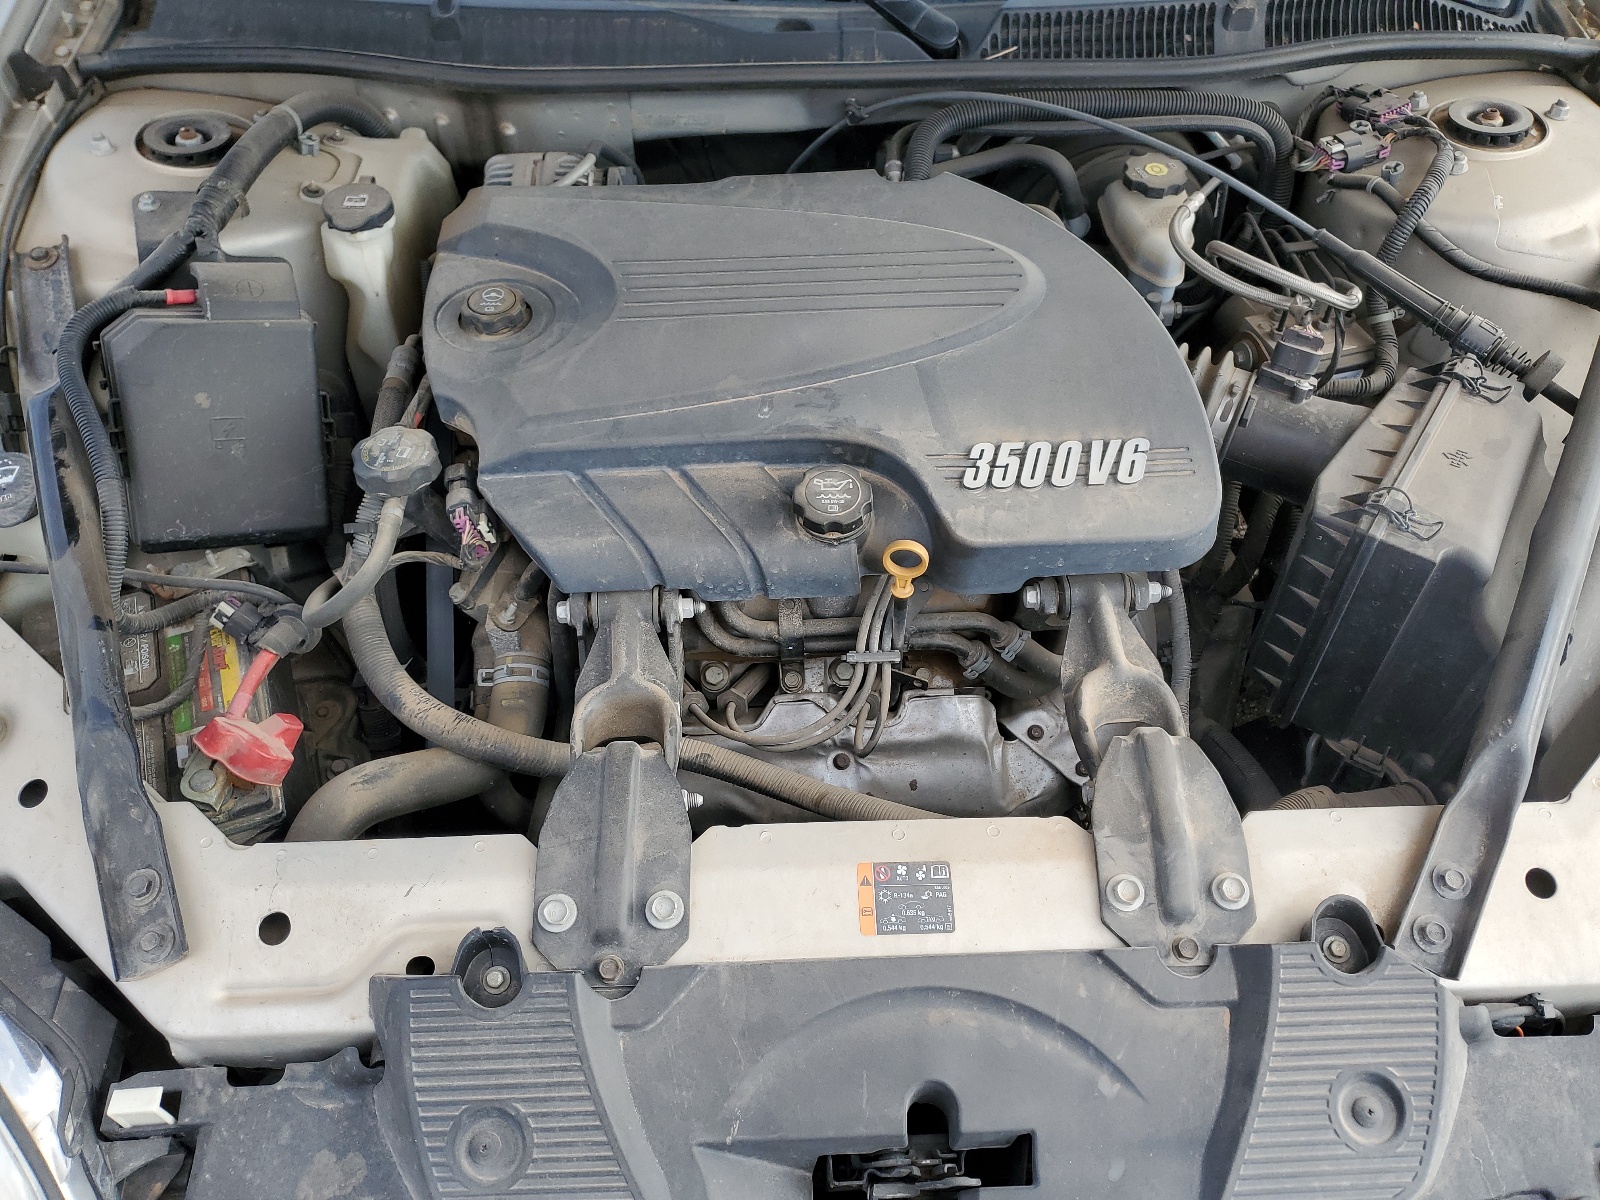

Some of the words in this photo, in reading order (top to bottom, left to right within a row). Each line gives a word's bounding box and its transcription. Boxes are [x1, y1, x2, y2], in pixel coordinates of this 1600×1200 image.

[962, 440, 1083, 490] 3500
[1086, 437, 1151, 487] V6
[140, 643, 150, 670] POISON
